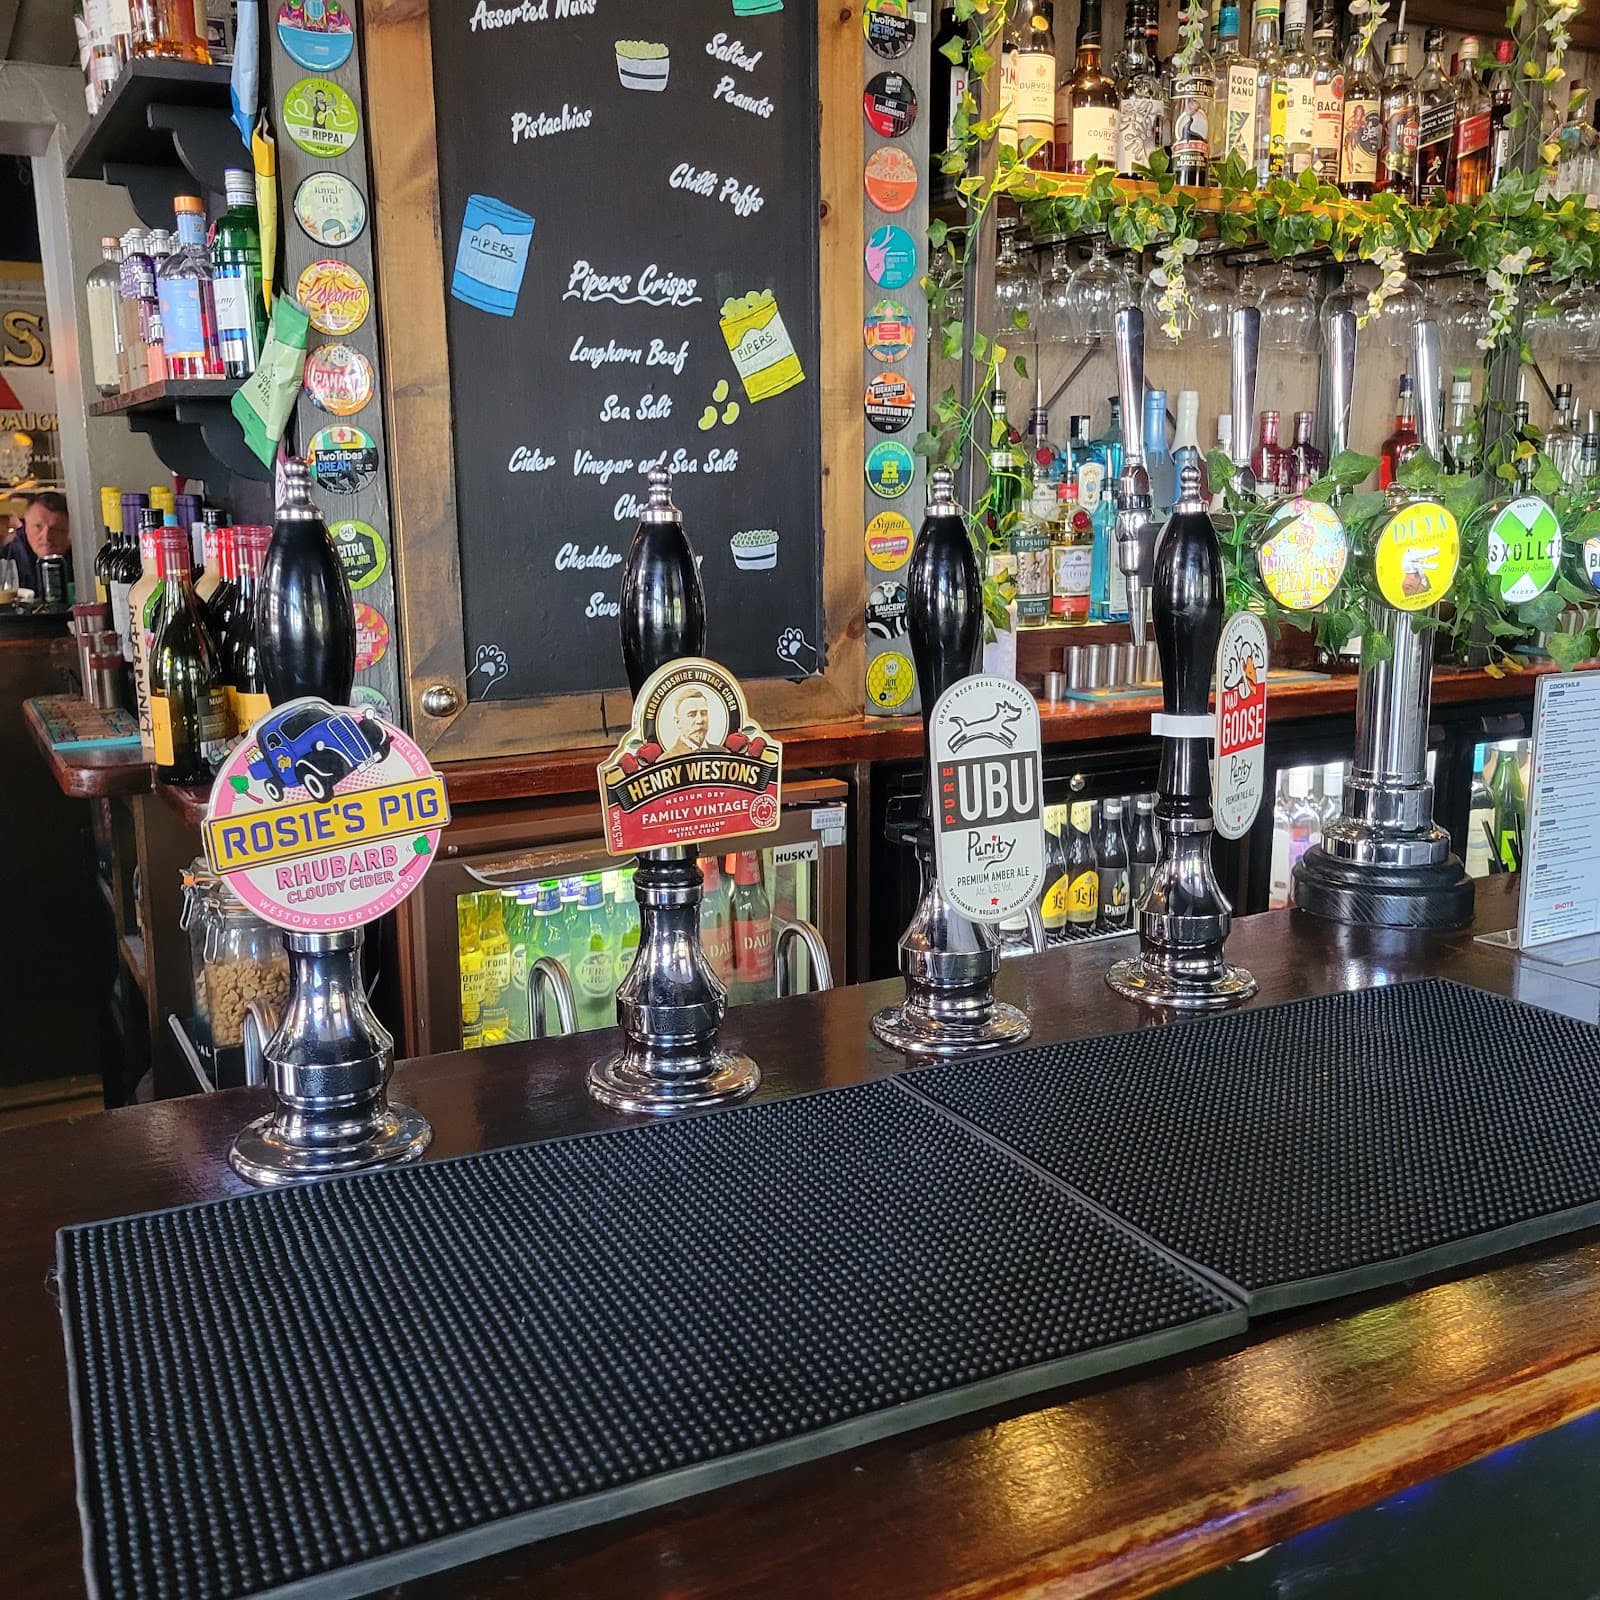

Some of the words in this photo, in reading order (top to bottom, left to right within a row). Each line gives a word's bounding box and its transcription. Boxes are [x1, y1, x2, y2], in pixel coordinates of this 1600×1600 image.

[469, 0, 548, 32] Assorted
[706, 32, 762, 73] Salted
[1232, 75, 1254, 85] KOKO
[1232, 88, 1254, 96] KANU
[712, 75, 774, 120] Peanuts
[312, 130, 343, 144] RIPPA!
[510, 103, 592, 144] Pistachios
[669, 162, 717, 198] Chilli
[719, 176, 764, 217] Puffs
[470, 234, 516, 258] PIPERS
[568, 260, 630, 299] Pipers
[637, 263, 698, 304] Crisps
[569, 336, 642, 369] Longhorn
[646, 339, 689, 374] Beef
[736, 331, 774, 360] PIPERS
[600, 394, 630, 422] Sea
[636, 394, 673, 422] Salt
[317, 450, 363, 460] TwoTribes
[318, 461, 352, 472] DREAM
[508, 446, 556, 472] Cider
[573, 450, 634, 485] Vinegar
[669, 448, 698, 473] Sea
[703, 448, 738, 472] Salt
[874, 518, 904, 534] Signal
[336, 542, 366, 558] CITRA
[555, 543, 622, 571] Cheddar
[646, 672, 693, 720] HEREFORDSHIRE
[695, 672, 724, 690] VINTAGE
[722, 684, 738, 712] CIDER
[1224, 692, 1238, 711] MAD
[1222, 704, 1264, 750] GOOSE
[628, 764, 682, 802] HENRY
[686, 761, 760, 784] WESTONS
[942, 766, 956, 824] PURE
[958, 757, 1034, 822] UBU
[642, 807, 692, 825] FAMILY
[694, 800, 748, 816] VINTAGE
[666, 794, 702, 805] MEDIUM
[776, 850, 814, 863] HUSKY
[968, 831, 1016, 872] Purity
[276, 845, 398, 890] RHUBARB
[957, 872, 990, 888] PREMIUM
[992, 868, 1015, 882] AMBER
[1016, 866, 1030, 878] ALE
[287, 880, 346, 904] CLOUDY
[350, 870, 396, 891] CIDER
[258, 898, 319, 927] WESTONS
[324, 911, 363, 926] CIDER
